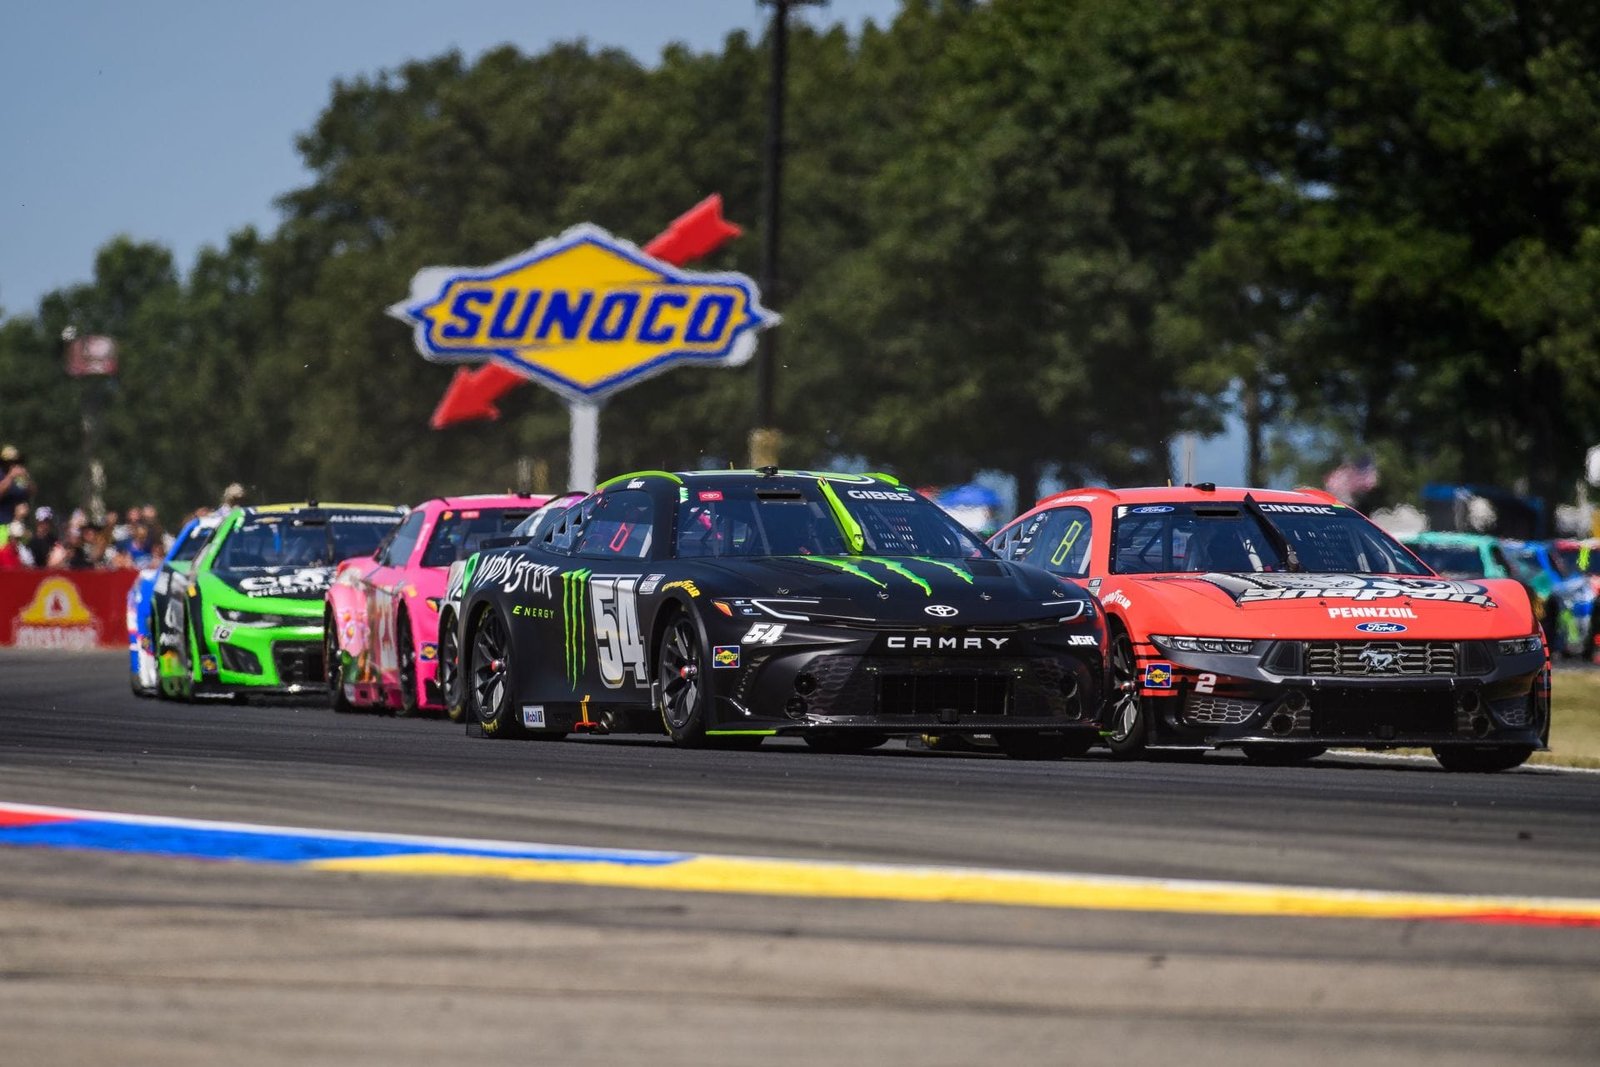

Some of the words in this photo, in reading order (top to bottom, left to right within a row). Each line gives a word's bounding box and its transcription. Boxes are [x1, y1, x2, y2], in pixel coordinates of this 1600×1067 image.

[441, 289, 741, 344] SUNOCO
[847, 490, 916, 502] GIBBS
[1258, 503, 1337, 516] CINDRIC
[473, 551, 559, 600] MONSTER
[512, 605, 554, 619] ENERGY
[1328, 607, 1418, 619] PENNZOIL
[588, 573, 650, 689] 54
[741, 622, 787, 645] 54
[1364, 622, 1399, 633] Ford
[887, 636, 1009, 649] CAMRY
[1067, 635, 1098, 646] JGR
[717, 653, 738, 661] SUNOCO
[1194, 673, 1217, 694] 2
